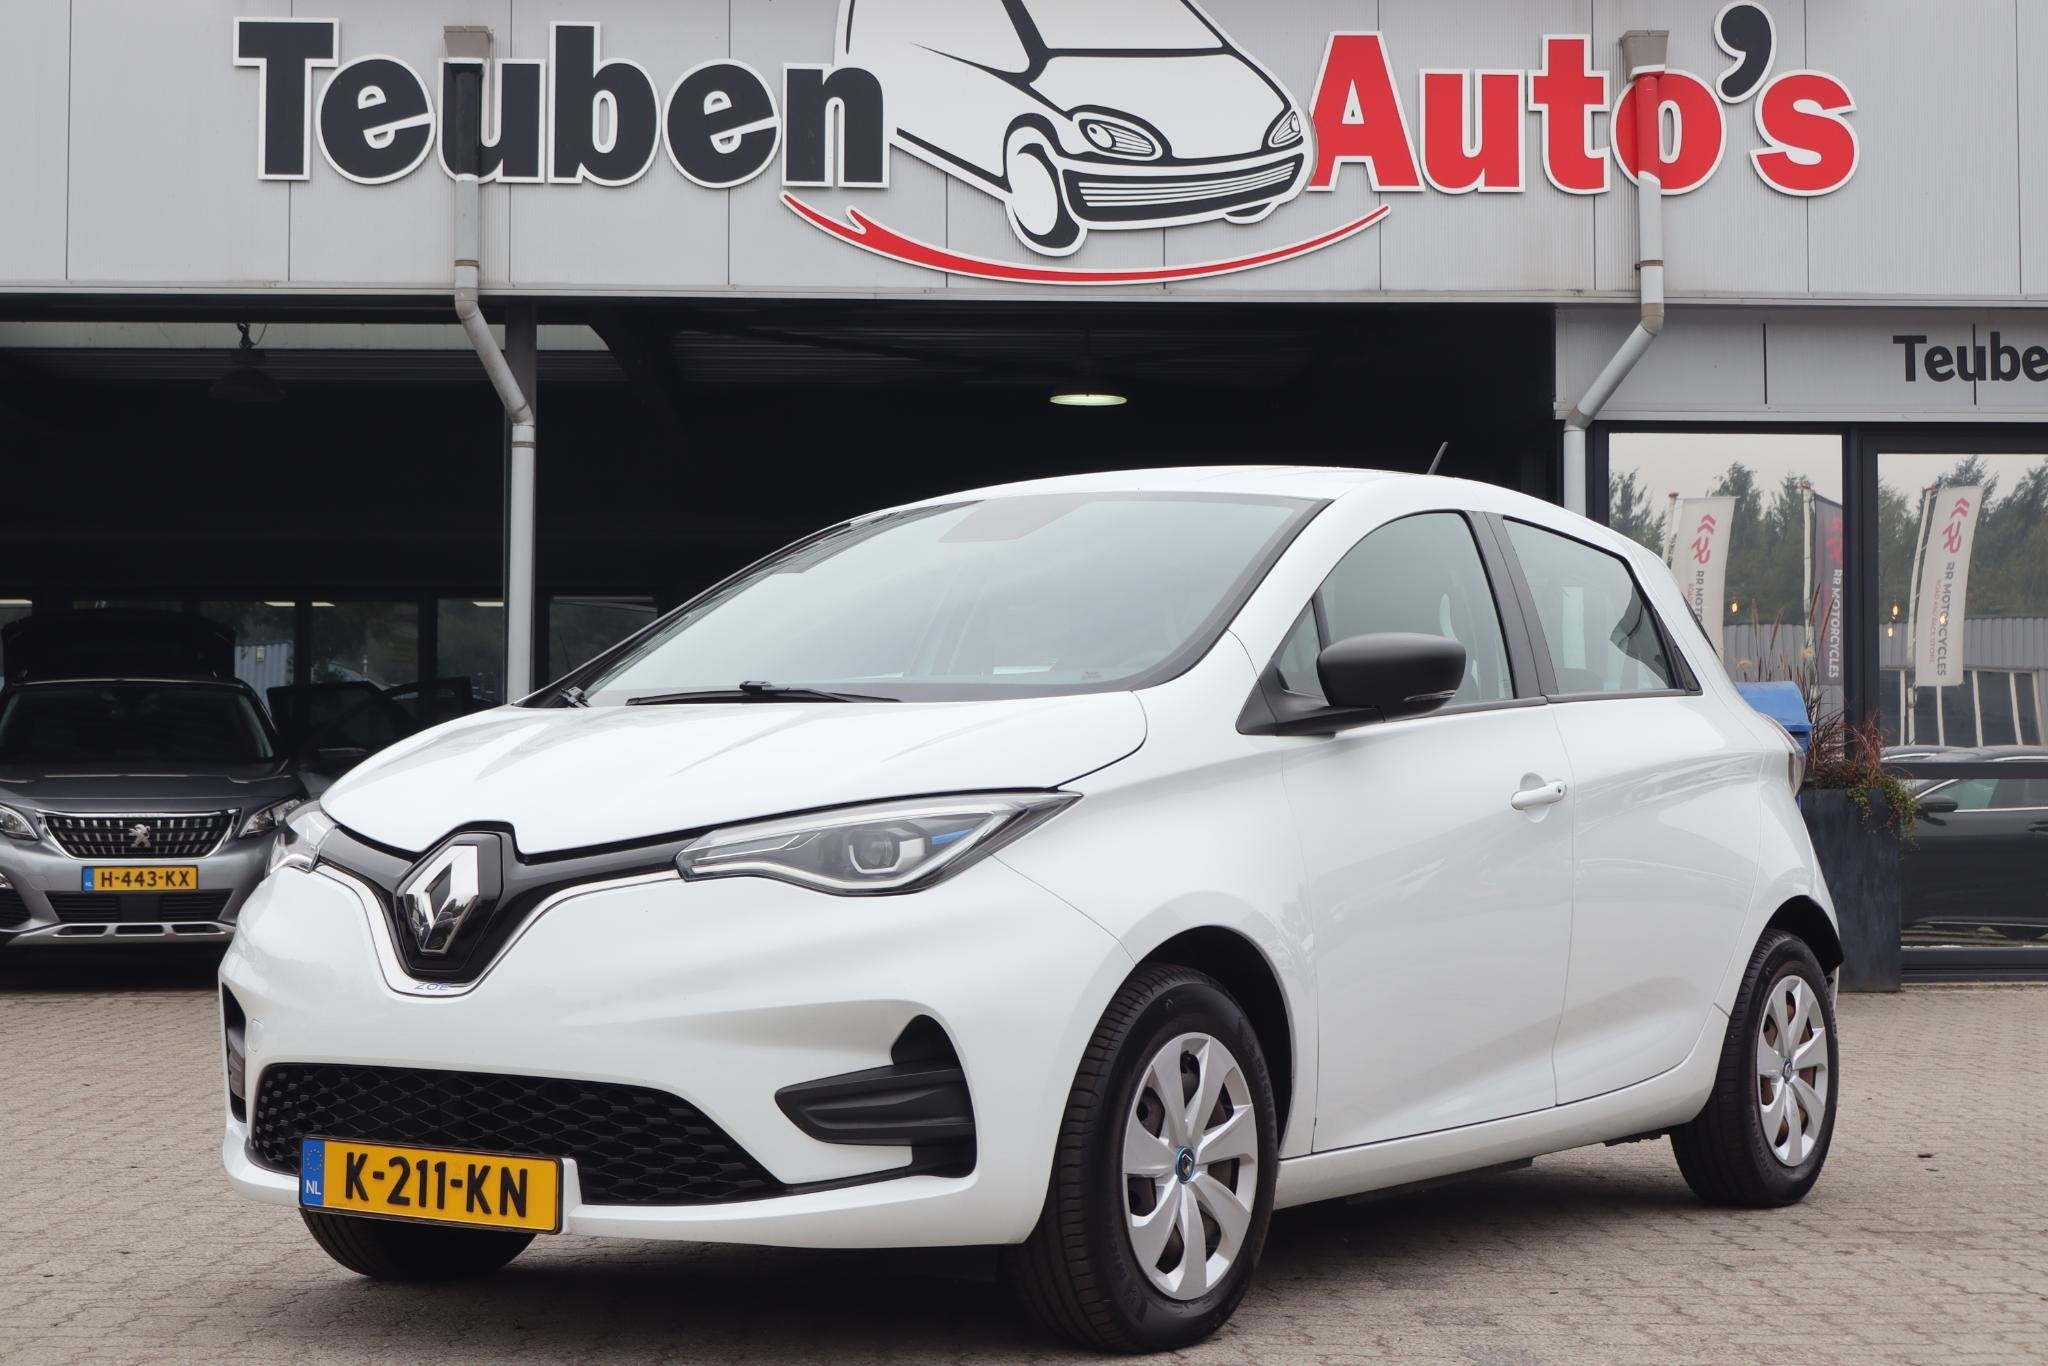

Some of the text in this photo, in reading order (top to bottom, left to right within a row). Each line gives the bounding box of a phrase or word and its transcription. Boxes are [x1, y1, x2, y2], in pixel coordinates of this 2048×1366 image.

[234, 1, 1860, 197] Teuben Auto's
[1892, 331, 2048, 382] Teube
[1696, 571, 1705, 586] RR
[1945, 562, 1954, 580] RR
[1829, 569, 1842, 678] RR MOTORCYCLES
[101, 870, 190, 888] H-443-KX
[415, 982, 450, 991] ZOE
[305, 1179, 322, 1196] NL
[345, 1151, 528, 1218] K-211-KN
